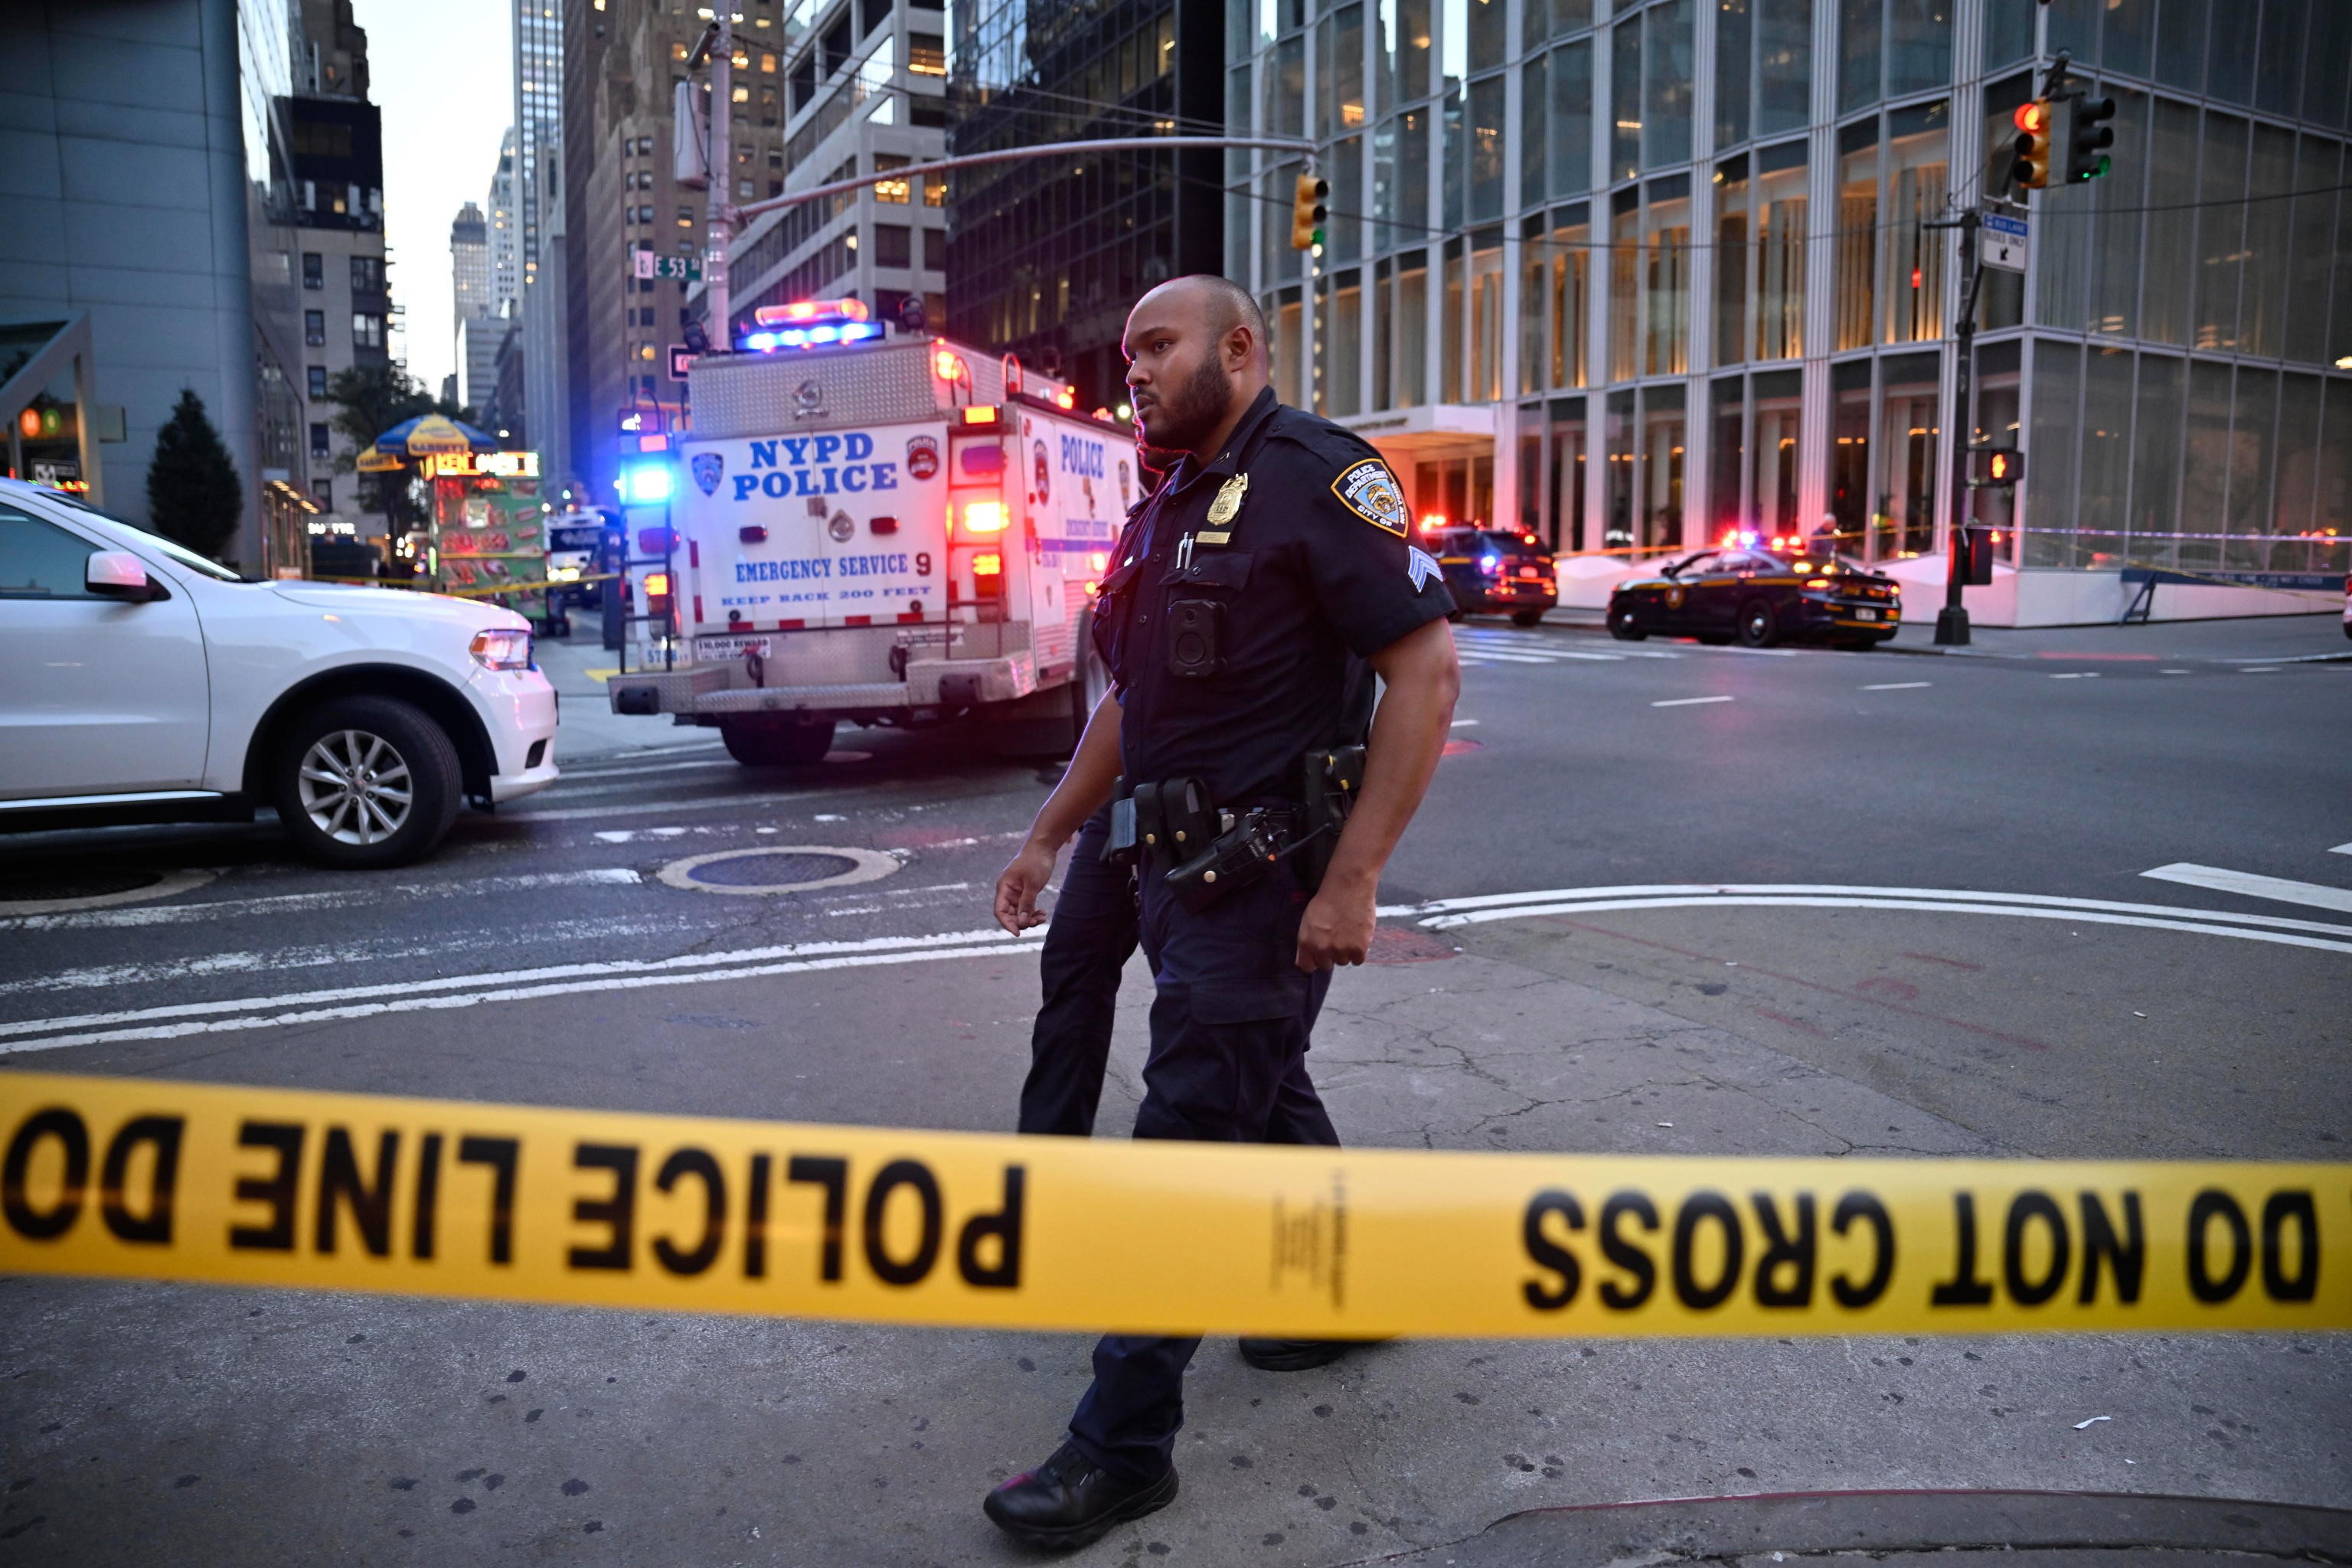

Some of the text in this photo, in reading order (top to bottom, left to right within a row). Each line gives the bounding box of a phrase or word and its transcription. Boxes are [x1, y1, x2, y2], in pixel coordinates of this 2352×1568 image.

[655, 256, 663, 276] E
[668, 257, 686, 278] 53
[750, 432, 874, 470] NYPD
[1061, 434, 1104, 479] POLICE
[733, 462, 898, 501] POLICE
[1345, 471, 1389, 499] DEPARTMENT
[1348, 464, 1375, 483] POLICE
[1357, 505, 1393, 527] CITY OF
[736, 552, 931, 583] EMERGENCY SERVICE 9
[721, 586, 932, 606] KEEP BACK 200 FEET
[0, 1105, 2324, 1312] DO NOT CROSS POLICE LINE DO
